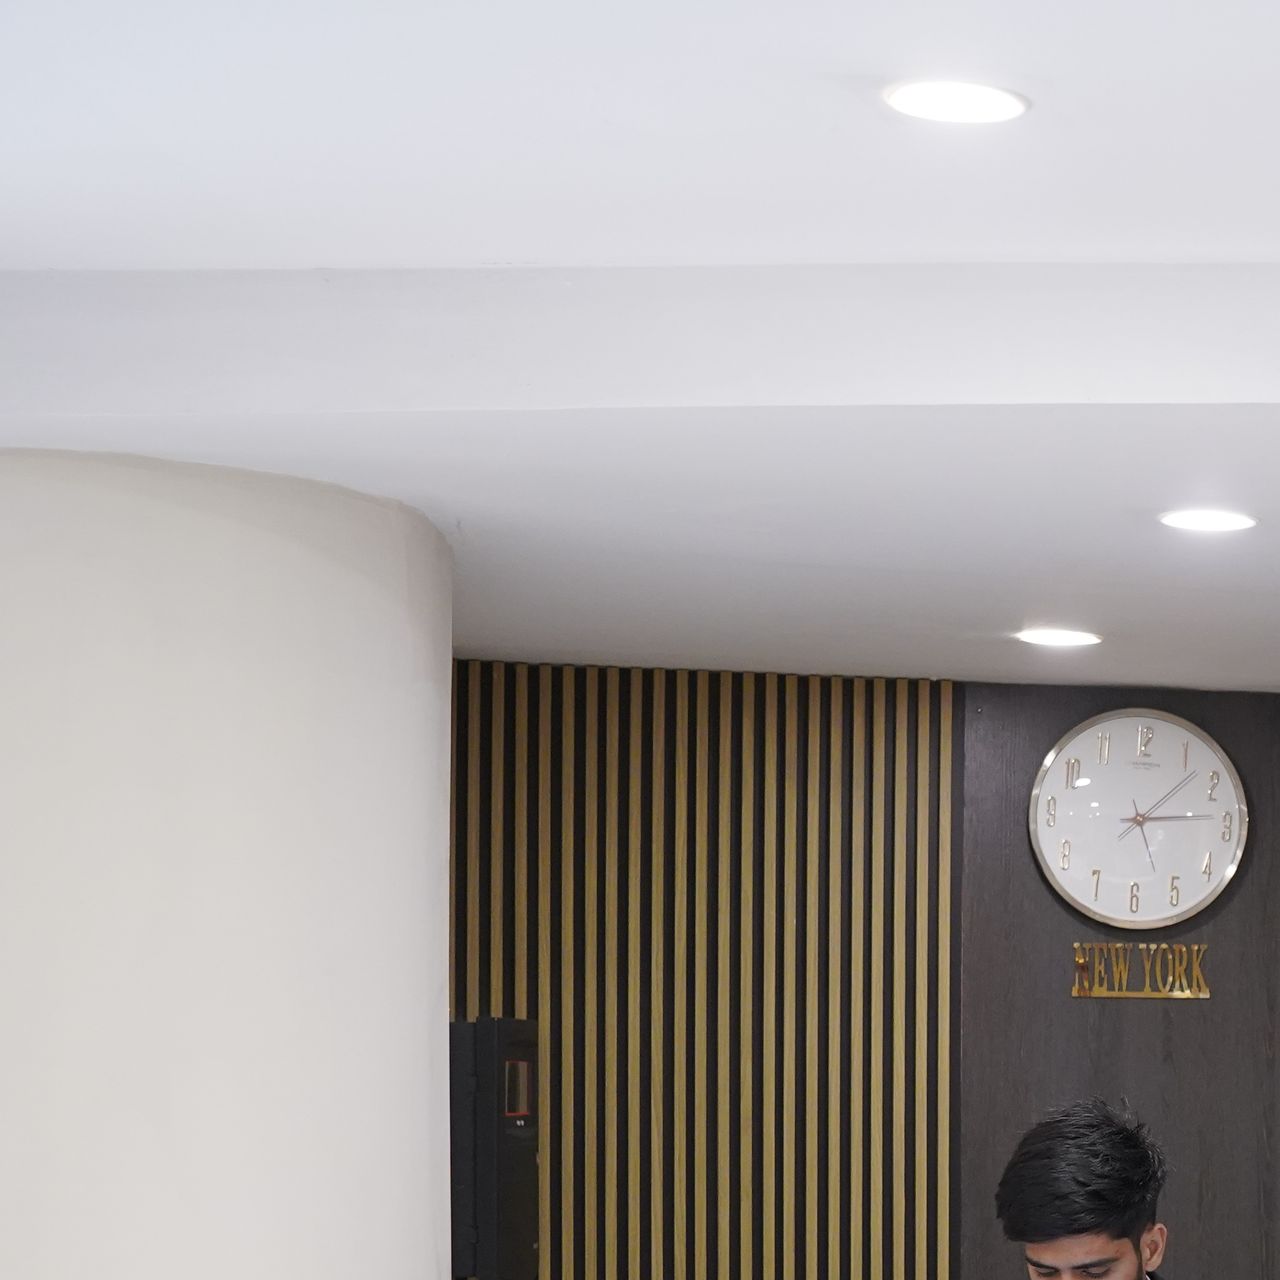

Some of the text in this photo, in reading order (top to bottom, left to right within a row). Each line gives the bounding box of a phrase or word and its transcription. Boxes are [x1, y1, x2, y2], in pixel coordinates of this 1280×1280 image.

[1097, 731, 1110, 765] 11
[1137, 724, 1154, 757] 12
[1065, 758, 1080, 790] 10
[1208, 770, 1219, 801] 2
[1047, 795, 1056, 827] 9
[1222, 811, 1232, 842] 3
[1061, 839, 1071, 871] 8
[1202, 851, 1212, 882] 4
[1092, 869, 1101, 901] 7
[1130, 882, 1139, 913] 6
[1170, 876, 1180, 906] 5
[1072, 943, 1210, 998] NEW YORK
